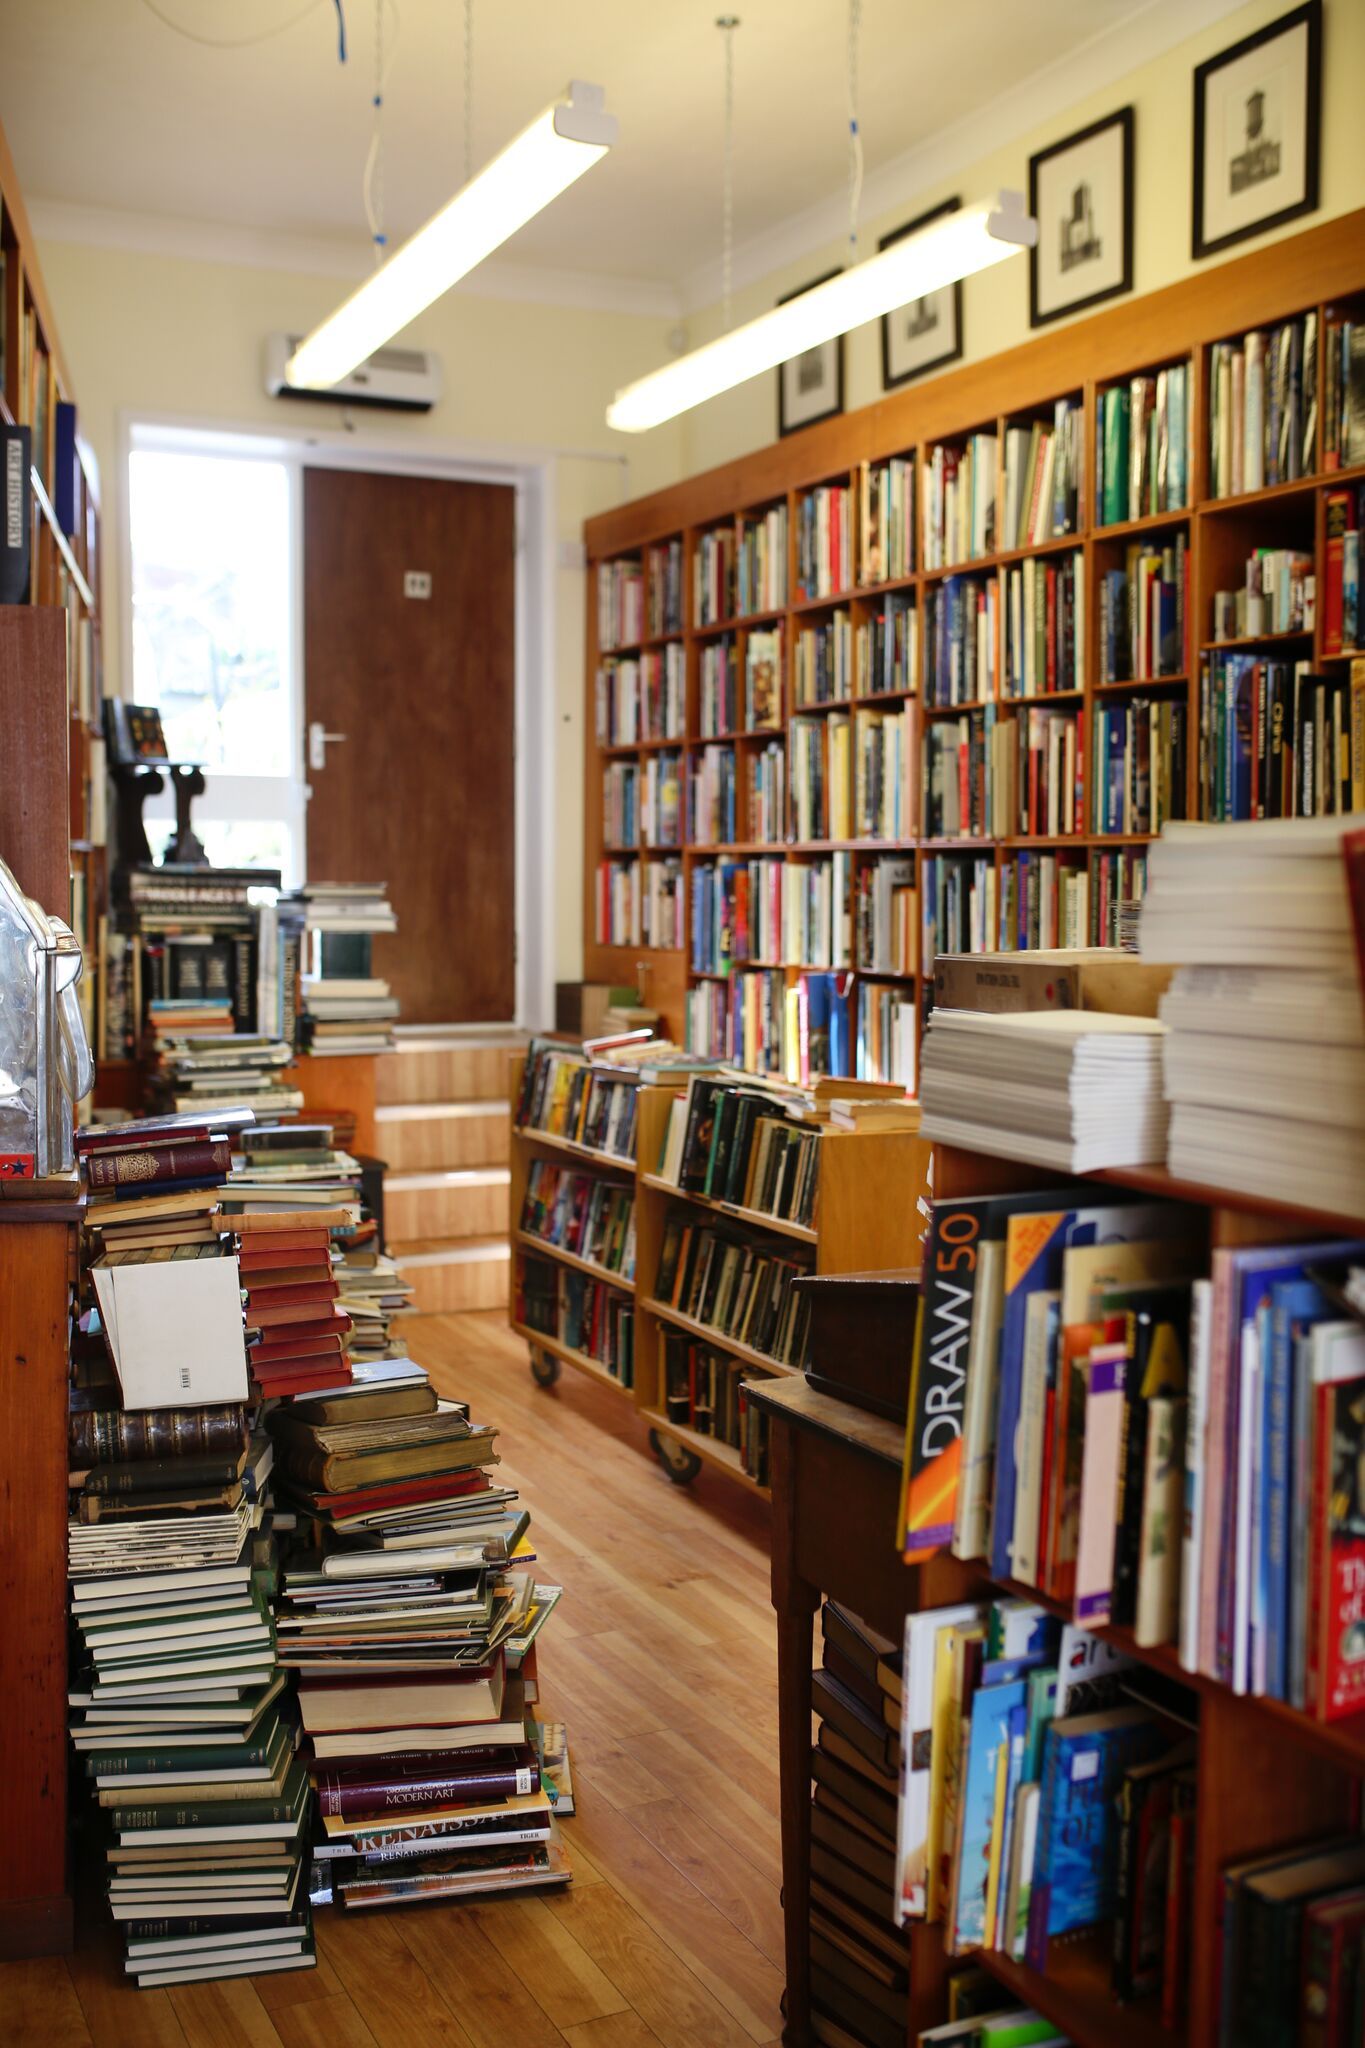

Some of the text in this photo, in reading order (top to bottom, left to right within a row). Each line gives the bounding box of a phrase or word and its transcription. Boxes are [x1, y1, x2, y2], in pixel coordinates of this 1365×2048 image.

[8, 444, 21, 545] ART HISTORY
[1271, 702, 1284, 754] China
[921, 1212, 980, 1458] DRAW 50
[385, 1788, 455, 1805] MODERN ART
[520, 1832, 540, 1840] TIGER
